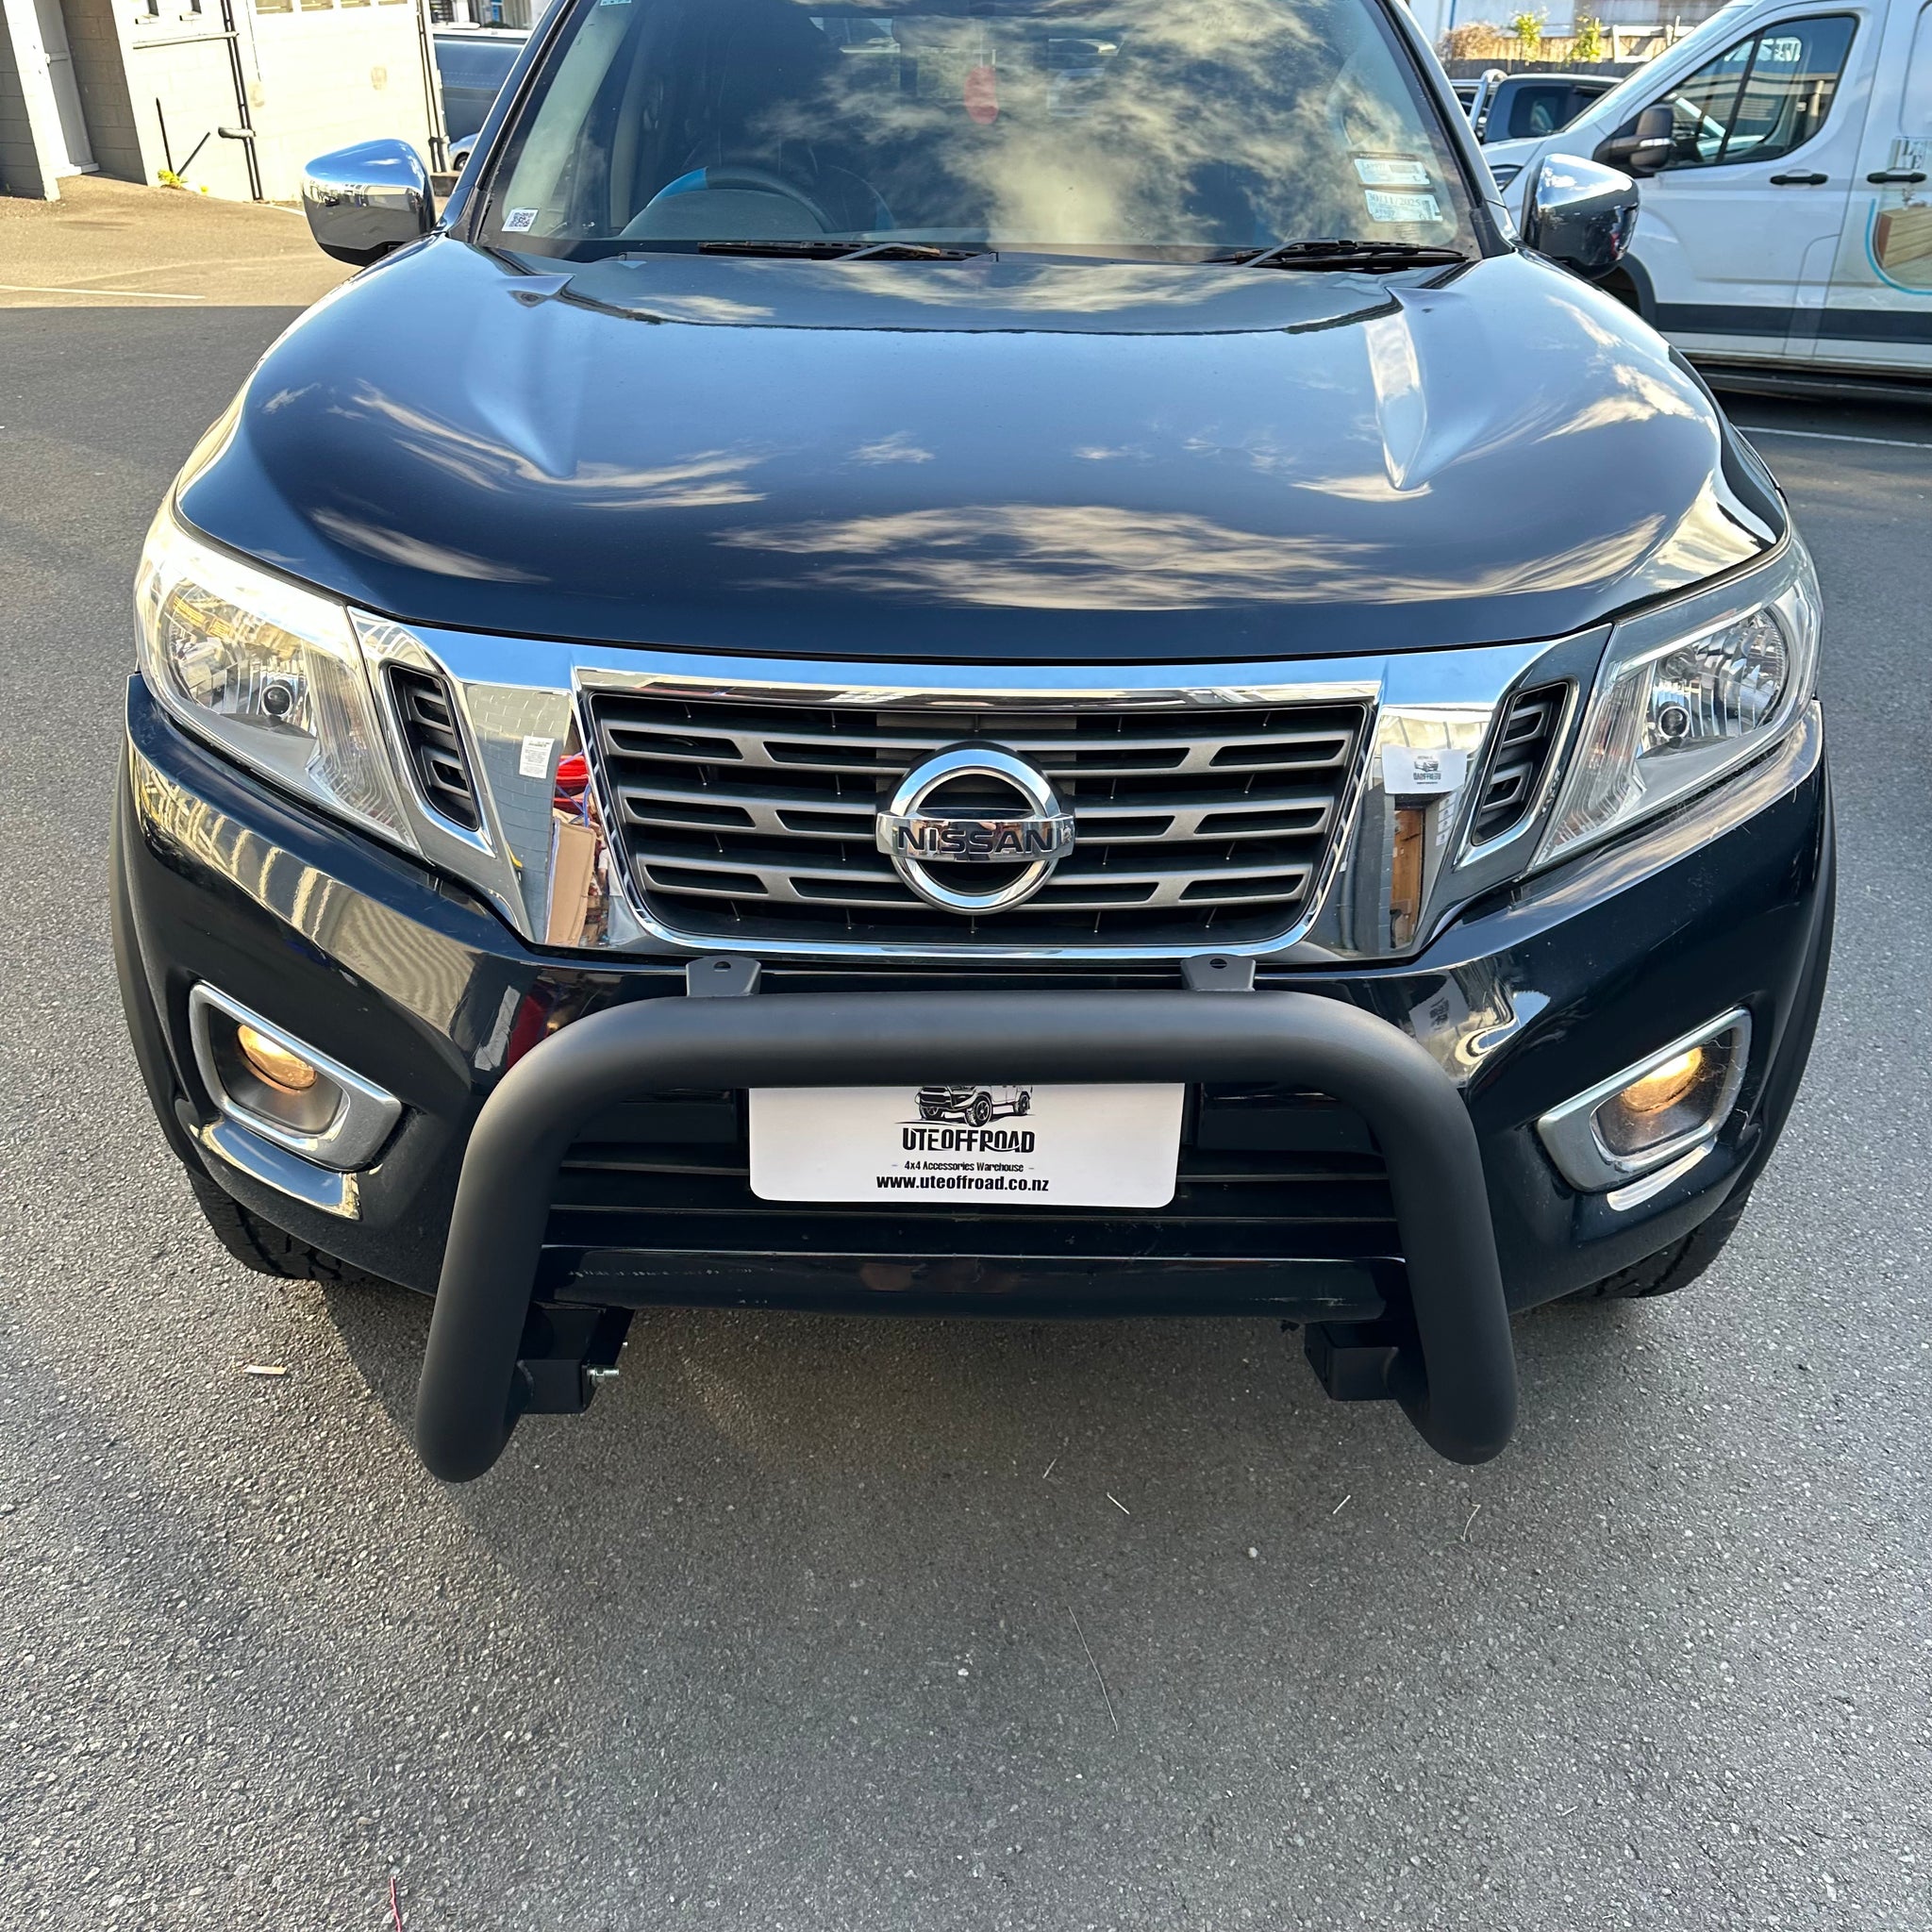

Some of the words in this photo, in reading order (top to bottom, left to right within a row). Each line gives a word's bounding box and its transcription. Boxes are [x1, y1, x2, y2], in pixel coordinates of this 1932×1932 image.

[897, 826, 1054, 854] NISSAN
[902, 1127, 1036, 1154] UTEOFFROAD
[904, 1160, 921, 1171] 4x4
[923, 1161, 975, 1172] Accessories
[976, 1161, 1024, 1173] Warehouse
[876, 1175, 1049, 1191] www.uteoffroad.co.nz
